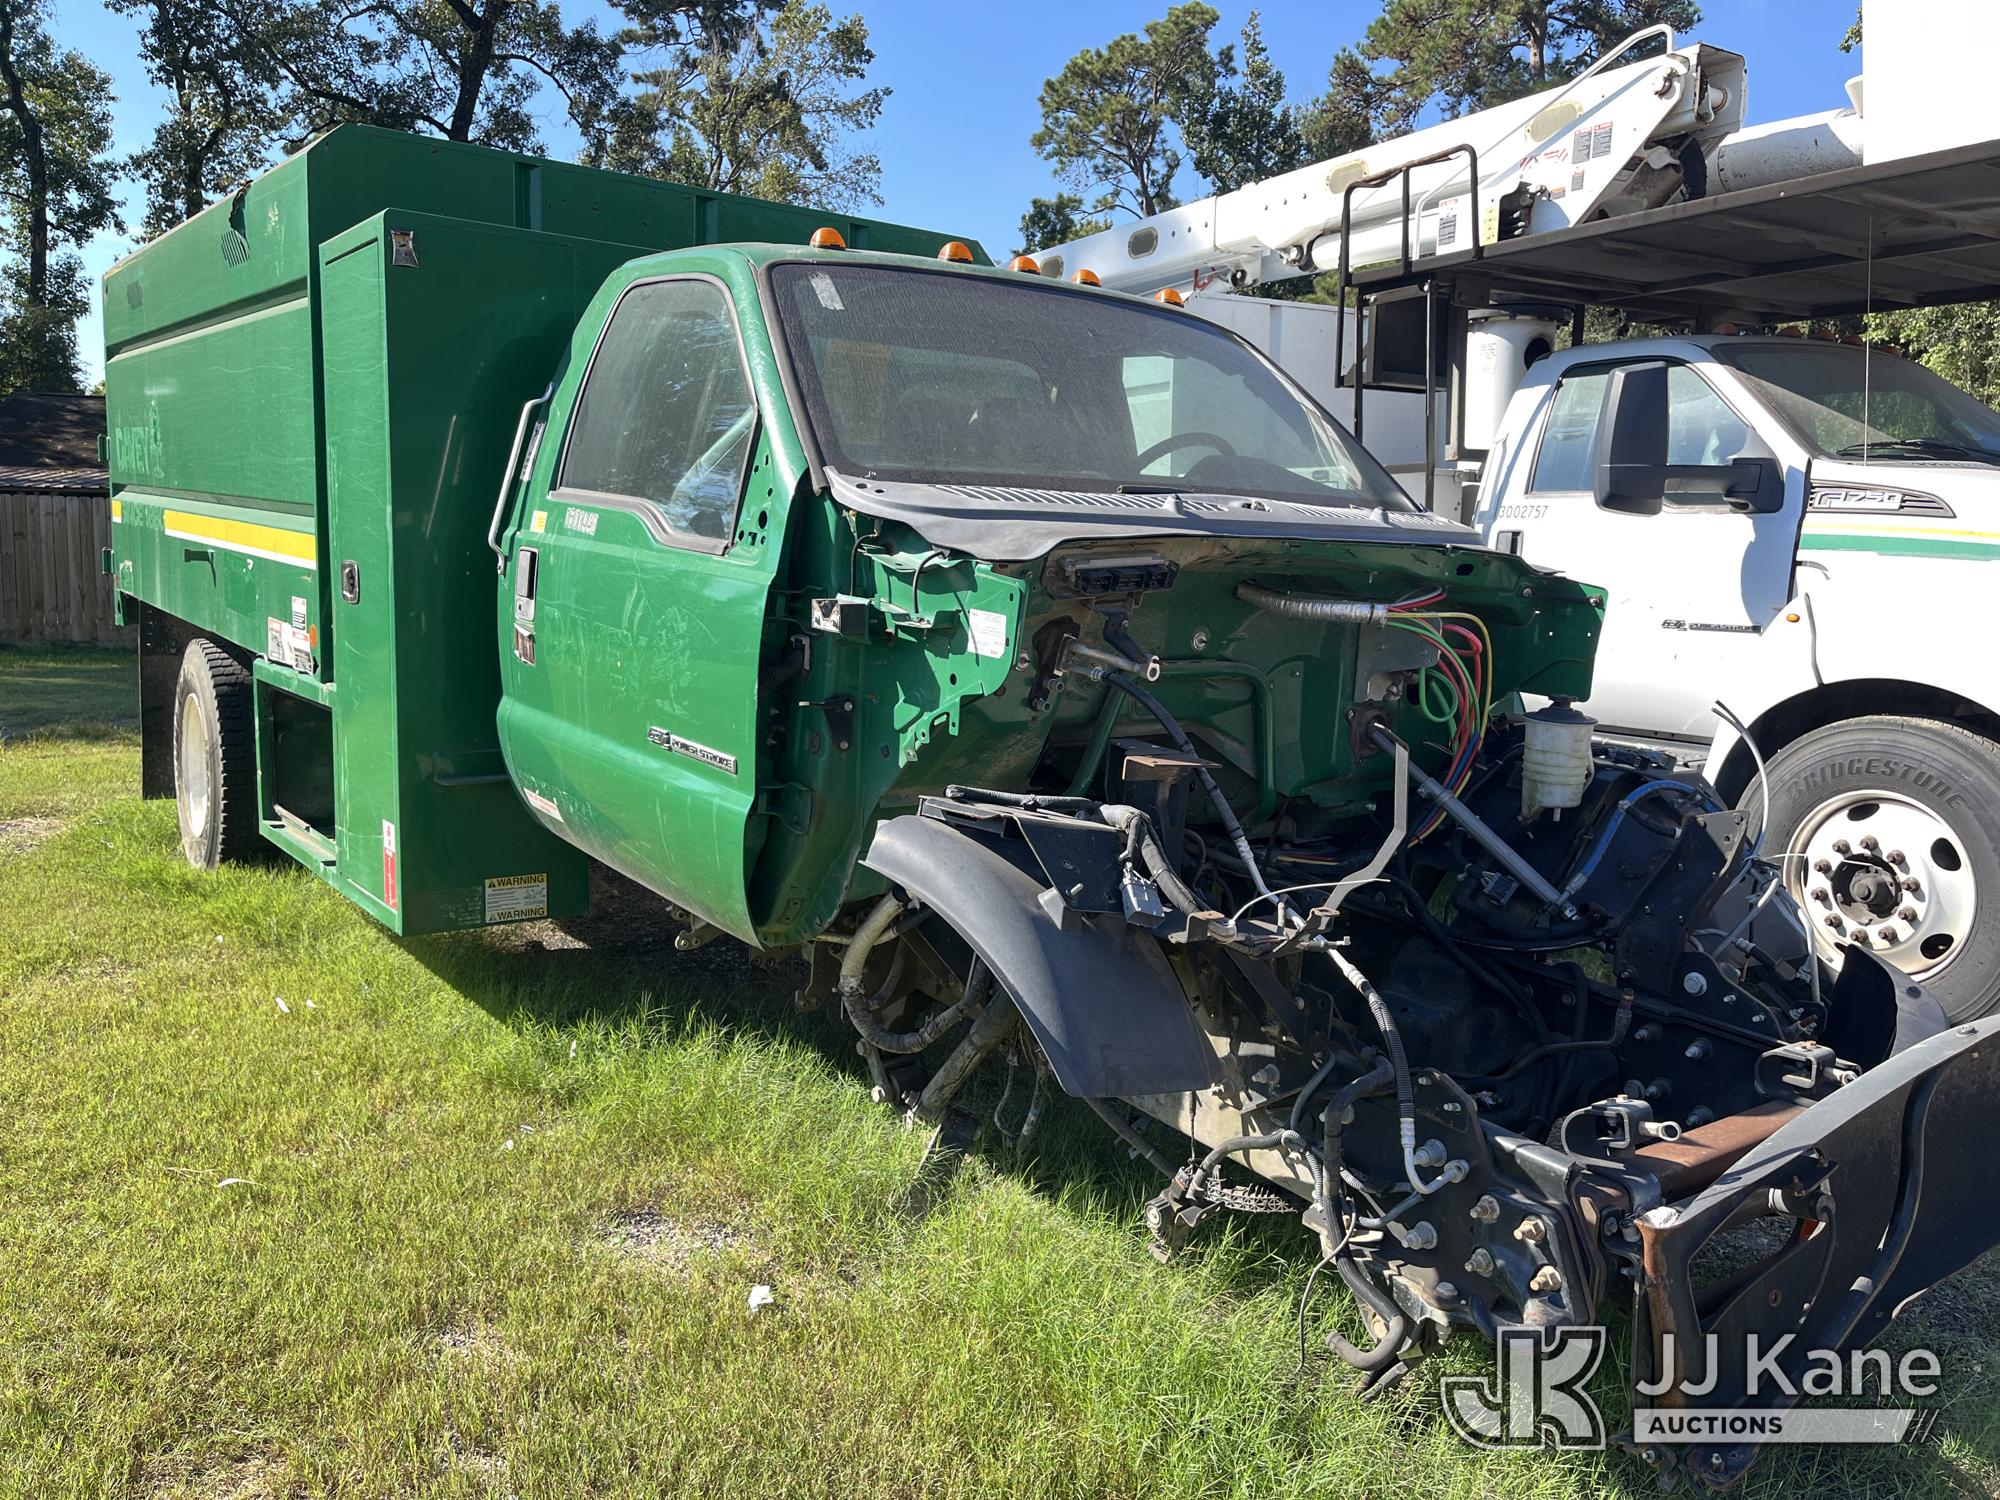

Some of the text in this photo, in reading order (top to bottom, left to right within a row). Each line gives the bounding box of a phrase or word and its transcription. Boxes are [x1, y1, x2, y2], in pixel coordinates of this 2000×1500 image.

[1499, 505, 1549, 519] 3002757
[1787, 757, 1968, 810] BRIDGESTONE
[497, 874, 545, 888] WARNING
[497, 907, 545, 920] WARNING
